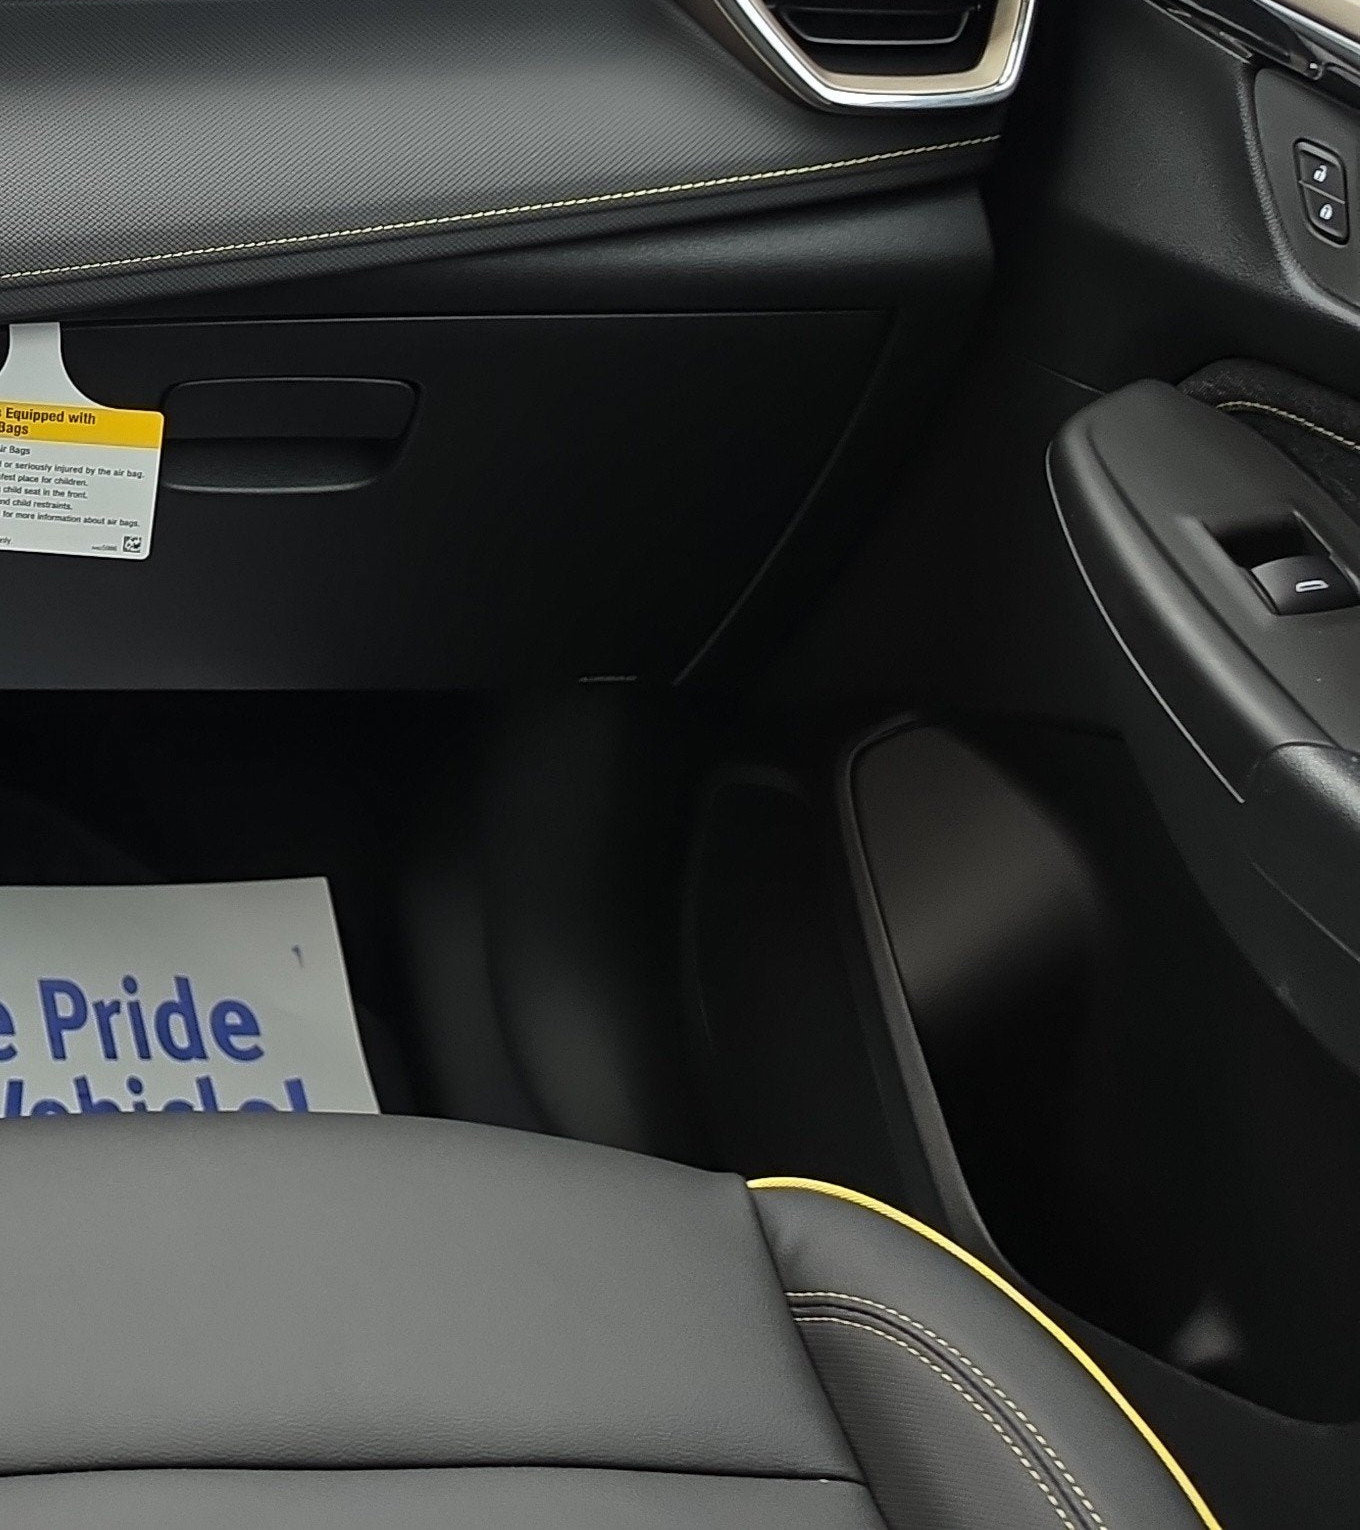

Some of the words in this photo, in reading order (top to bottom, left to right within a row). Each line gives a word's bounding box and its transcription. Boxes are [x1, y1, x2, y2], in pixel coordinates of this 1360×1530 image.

[5, 407, 65, 424] Equipped
[68, 412, 96, 425] with
[9, 445, 31, 456] Bags
[15, 462, 53, 473] seriously
[53, 464, 84, 475] injured
[85, 466, 96, 476] by
[97, 467, 112, 476] the
[113, 468, 125, 477] air
[17, 474, 39, 484] place
[41, 475, 53, 484] for
[2, 485, 23, 494] child
[23, 488, 41, 496] seat
[52, 489, 65, 498] the
[12, 498, 32, 507] child
[2, 510, 14, 518] for
[15, 511, 35, 520] more
[36, 513, 82, 523] information
[83, 516, 105, 525] about
[106, 518, 118, 526] air
[38, 974, 264, 1062] Pride
